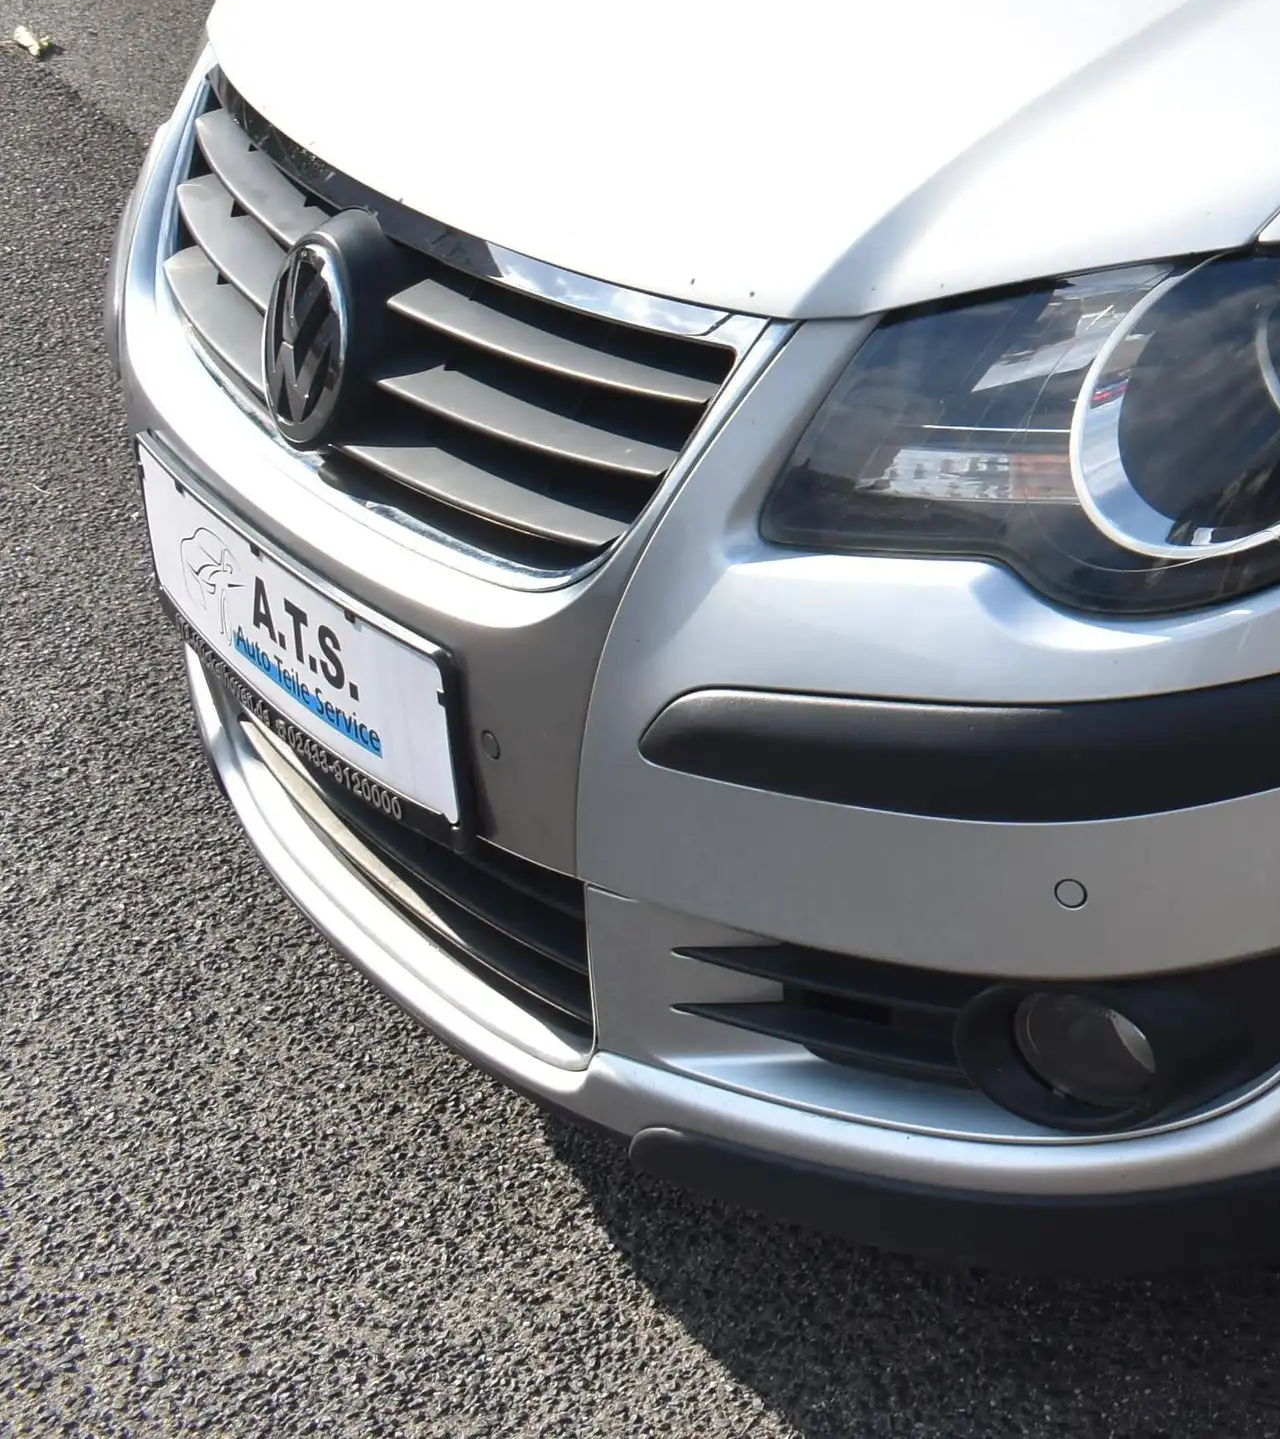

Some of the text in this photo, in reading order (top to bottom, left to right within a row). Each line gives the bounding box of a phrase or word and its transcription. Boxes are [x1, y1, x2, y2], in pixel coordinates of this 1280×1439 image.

[236, 625, 381, 752] Auto Teile Service
[253, 576, 360, 701] A.T.S.
